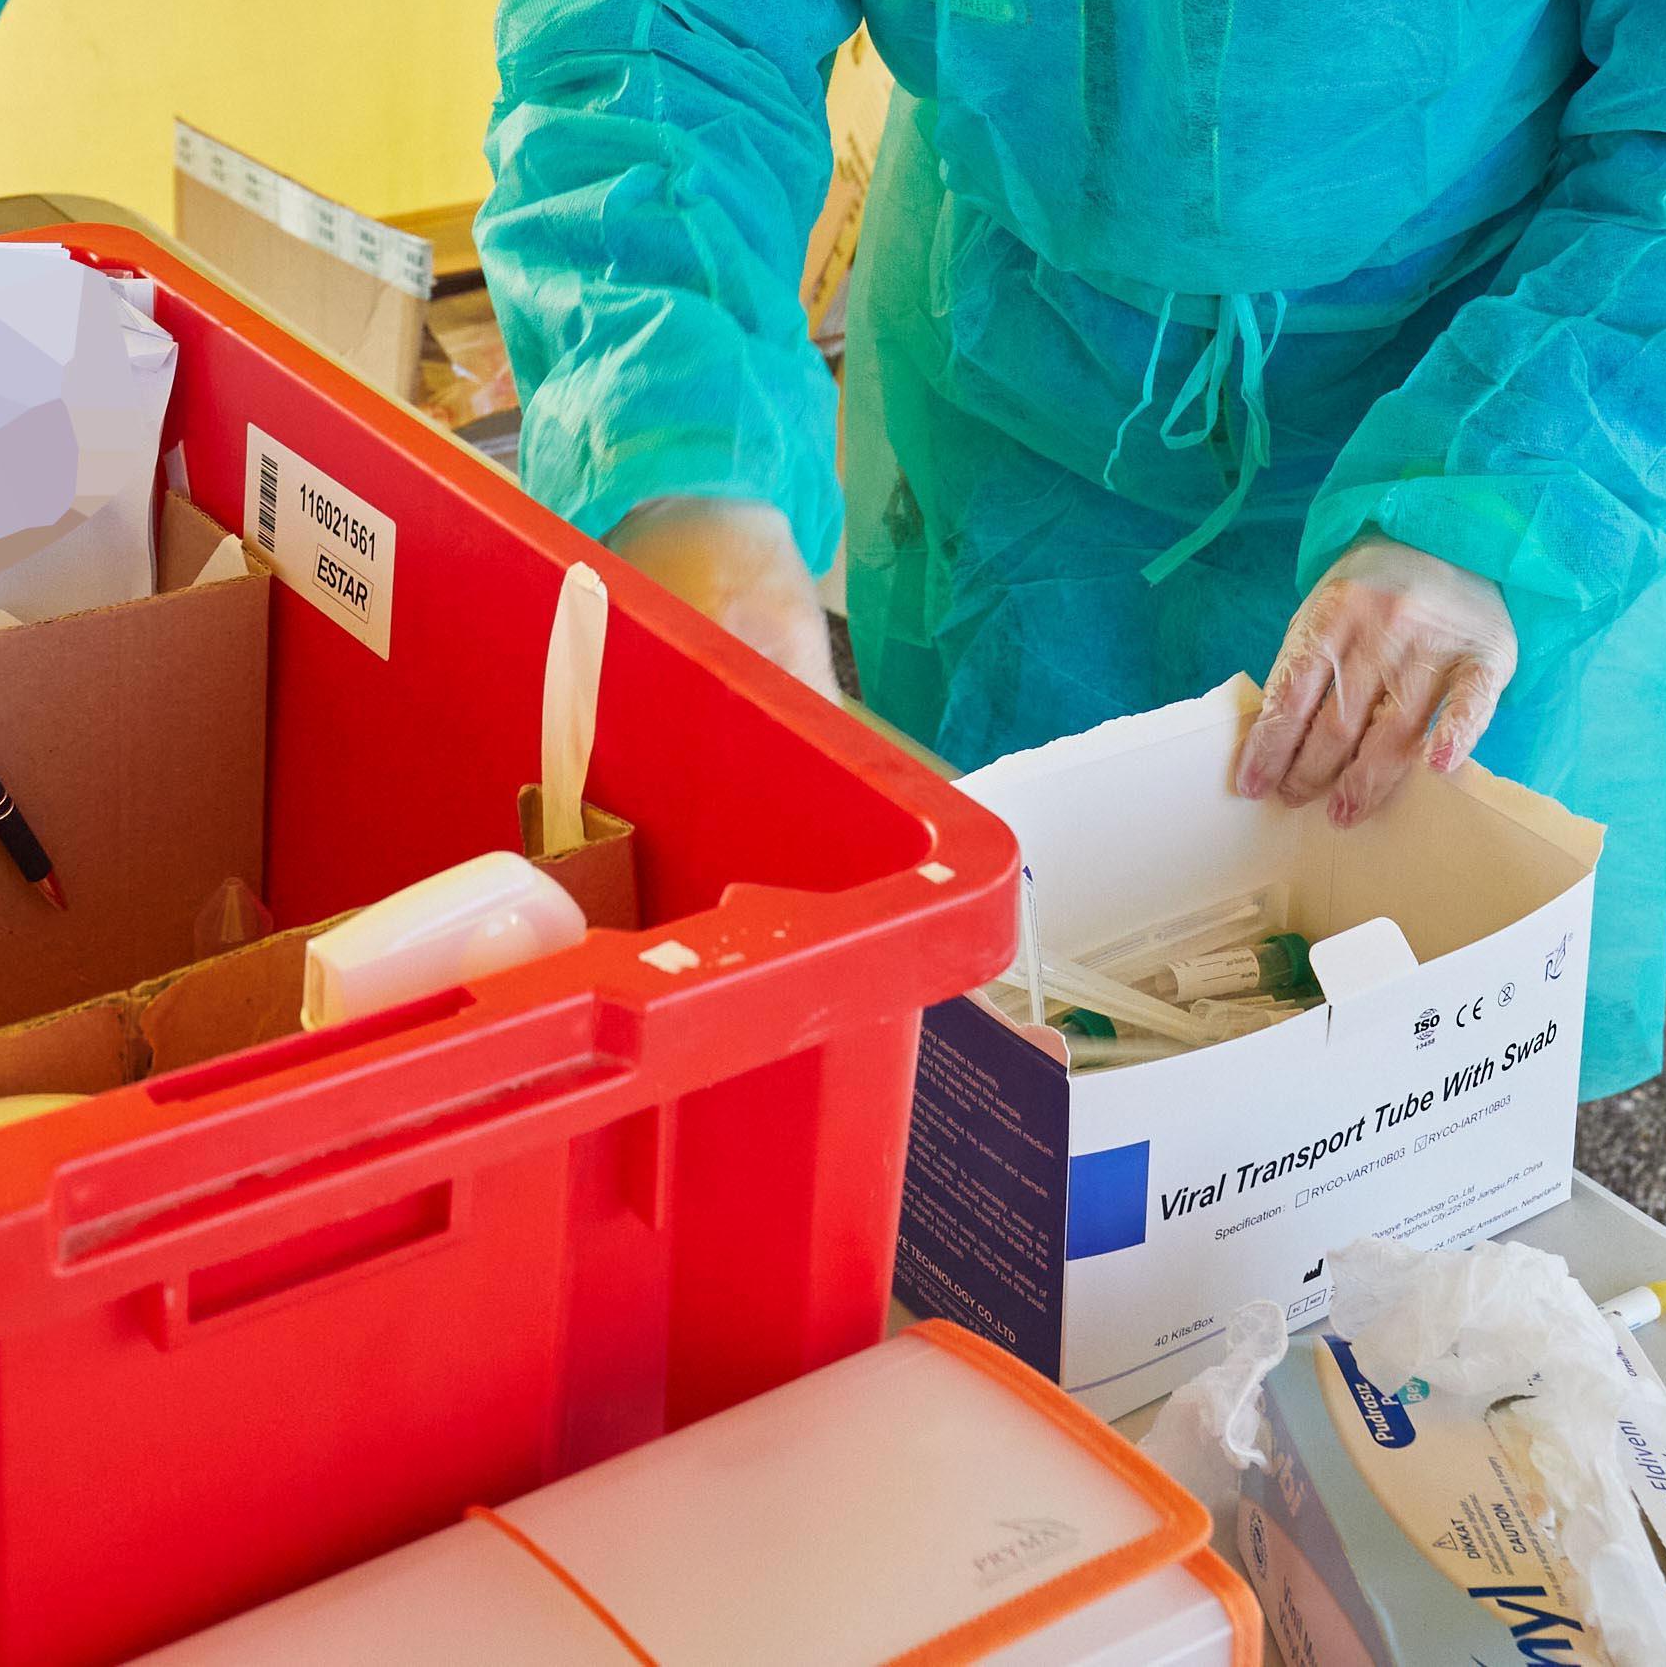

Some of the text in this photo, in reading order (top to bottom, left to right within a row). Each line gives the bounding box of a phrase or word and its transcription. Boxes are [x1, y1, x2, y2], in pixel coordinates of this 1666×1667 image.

[300, 483, 376, 561] 116021561
[316, 554, 368, 612] ESTAR
[1414, 1014, 1440, 1035] ISO
[1455, 996, 1484, 1027] CE
[1161, 1020, 1558, 1221] Viral Transport Tube With Swab
[1311, 1147, 1406, 1199] RYCO-VART10B03
[1428, 1095, 1512, 1145] RYCO-IART10B03
[1403, 1201, 1446, 1227] Technology
[898, 1235, 909, 1251] YE
[910, 1245, 976, 1308] TECHNOLOGY
[1154, 1315, 1215, 1348] 40 Kits/Box
[1407, 1375, 1424, 1402] Bey
[1491, 1503, 1527, 1555] CAUTION
[1467, 1585, 1586, 1667] nyl
